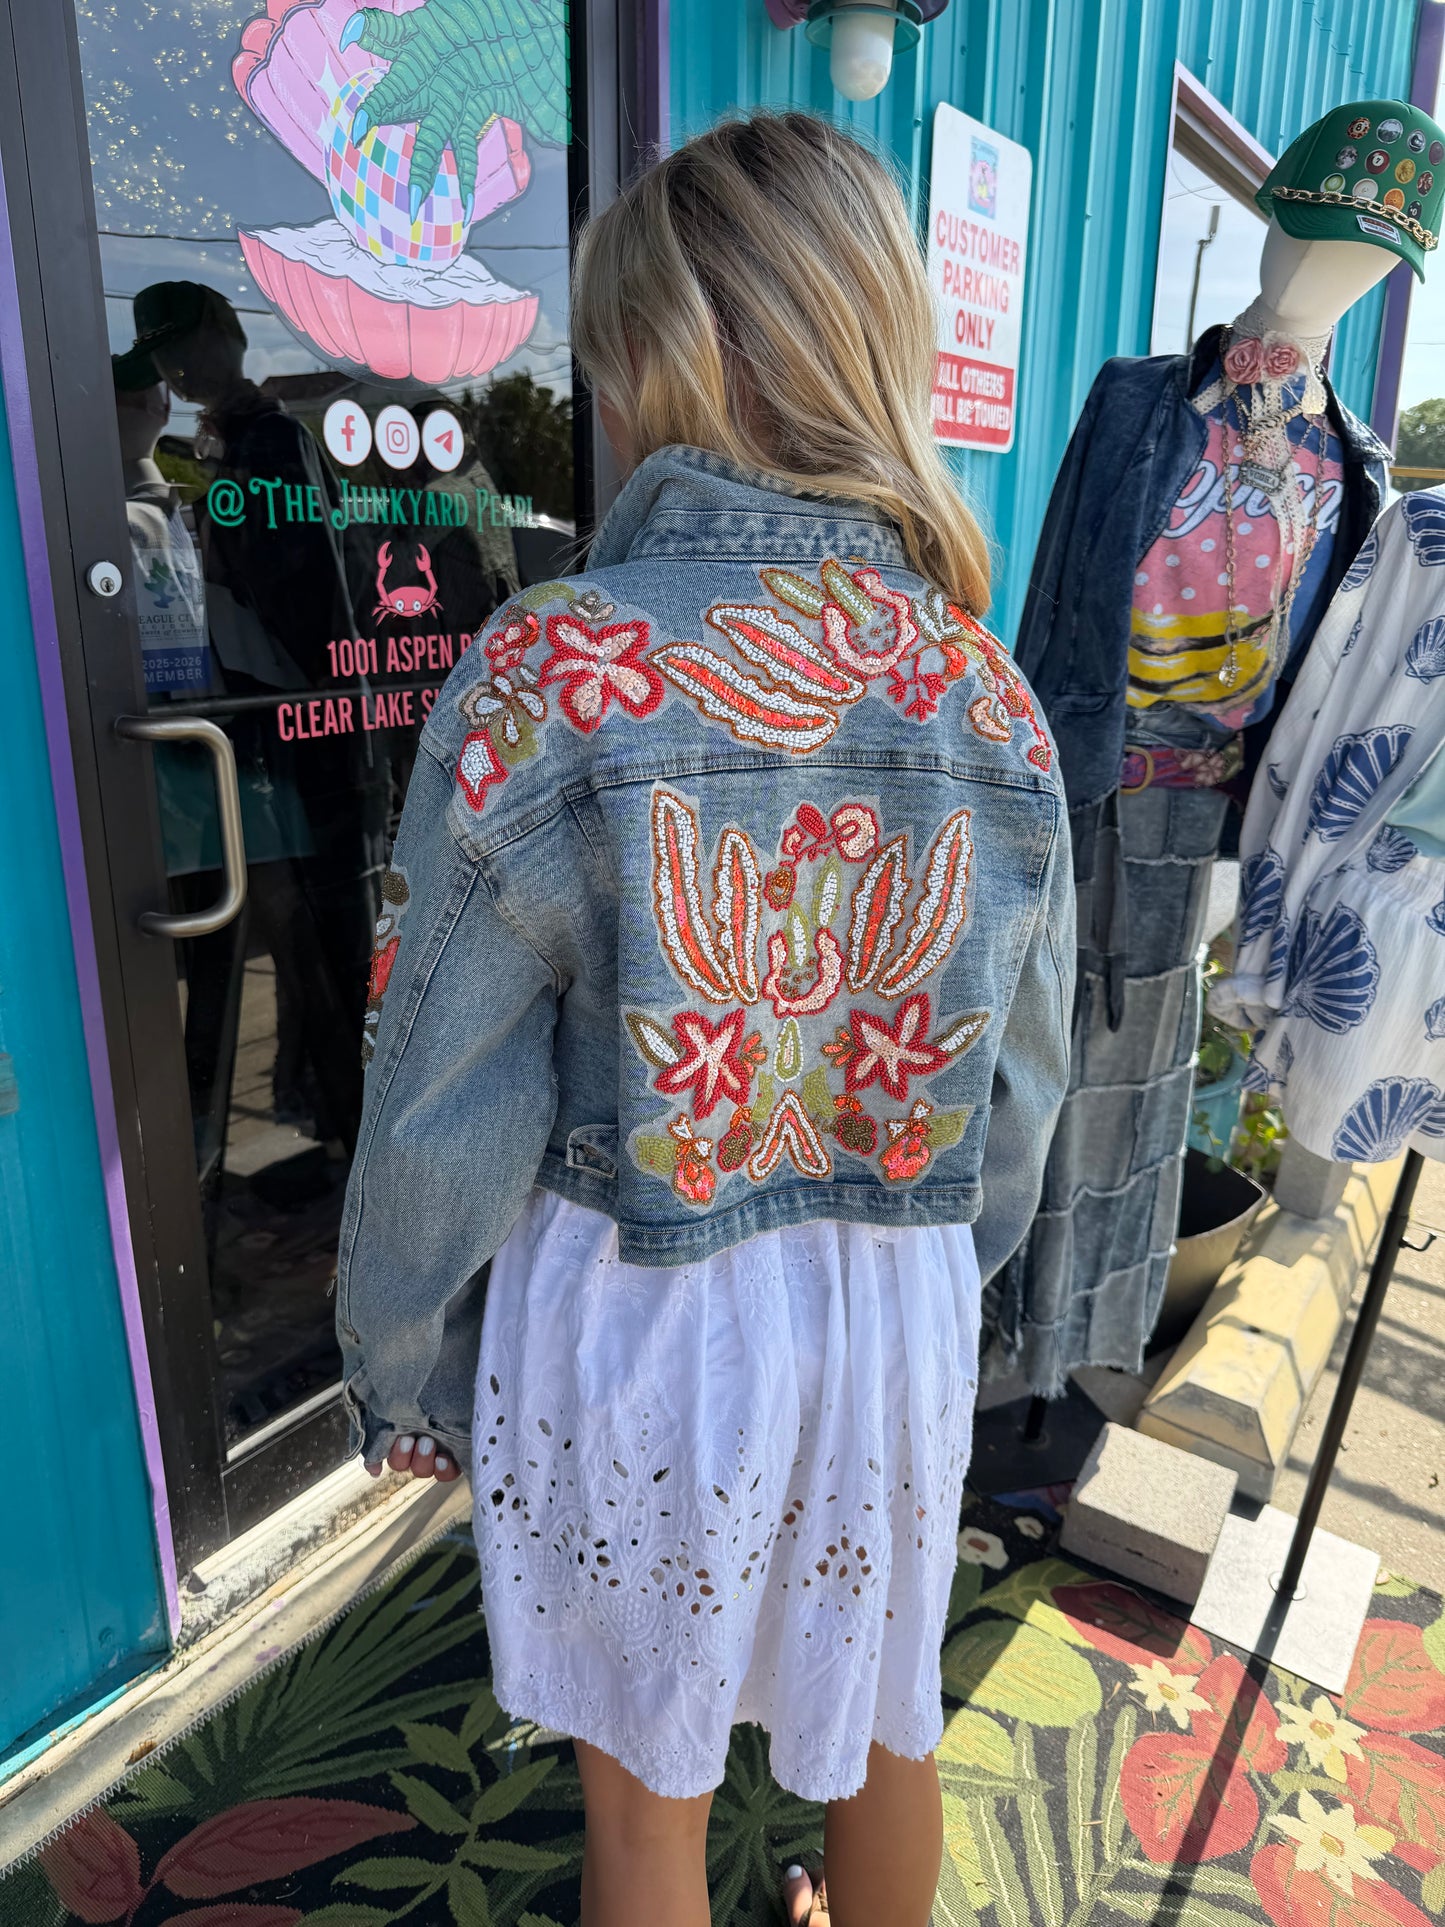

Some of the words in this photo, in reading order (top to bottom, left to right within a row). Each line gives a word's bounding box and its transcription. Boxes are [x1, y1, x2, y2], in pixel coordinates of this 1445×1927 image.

[936, 209, 1019, 275] CUSTOMER
[943, 259, 1009, 314] PARKING
[955, 308, 995, 351] ONLY
[937, 361, 960, 391] ALL
[961, 366, 1005, 399] OTHERS
[974, 400, 1011, 431] TOWED
[331, 478, 469, 531] JUNKYARD
[139, 614, 175, 625] EAGUE
[143, 657, 201, 669] 2025-2026
[145, 670, 203, 683] MEMBER
[327, 638, 379, 678] 1001
[386, 634, 453, 673] ASPEN
[277, 697, 355, 742] CLEAR
[361, 691, 415, 731] LAKE
